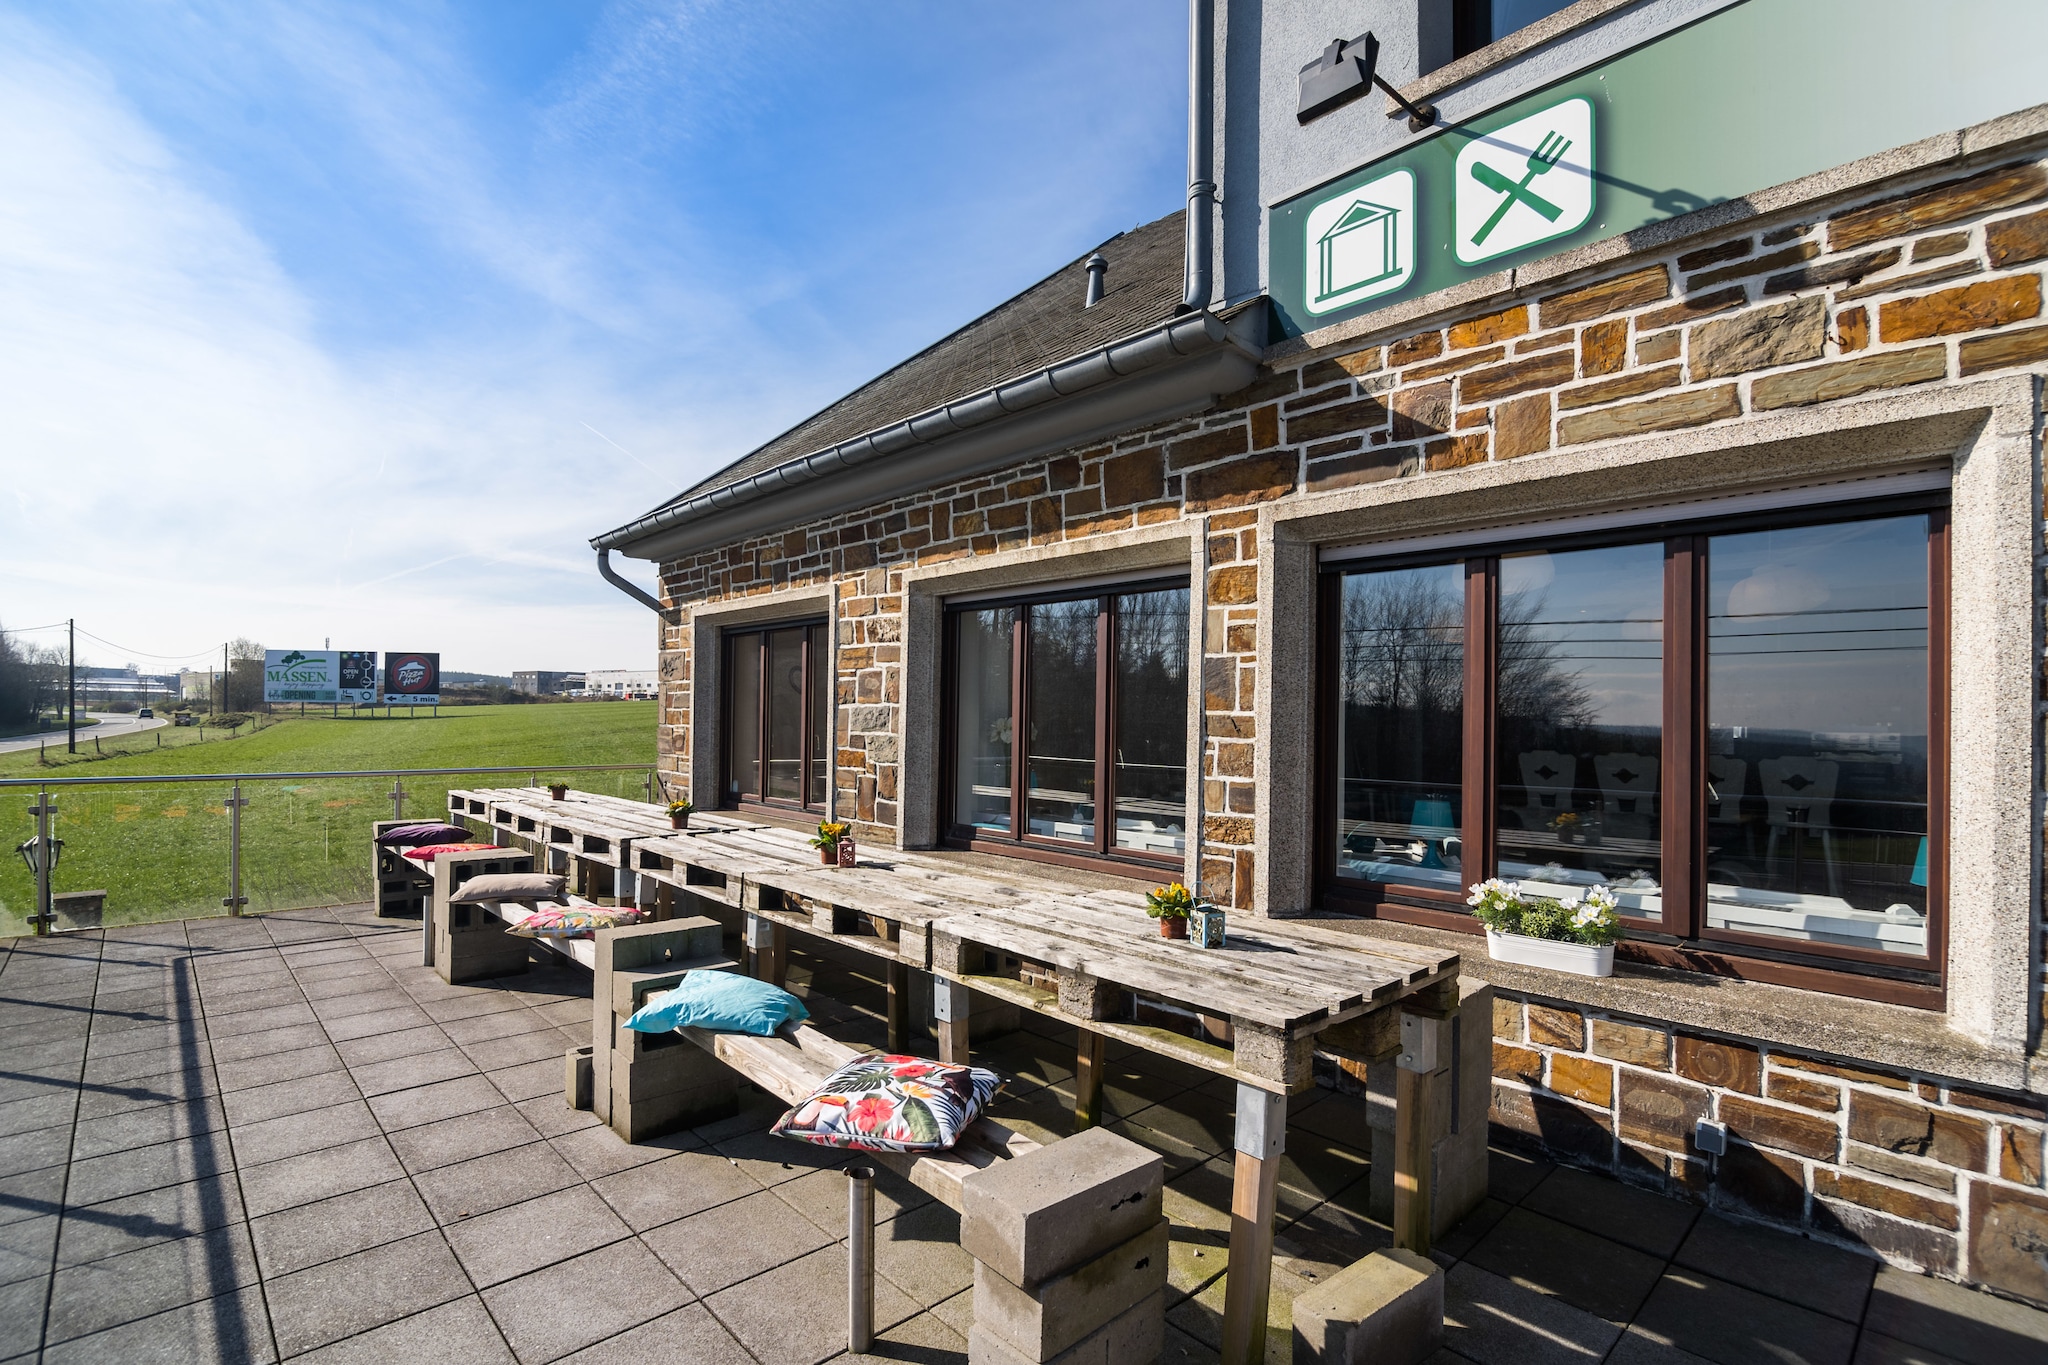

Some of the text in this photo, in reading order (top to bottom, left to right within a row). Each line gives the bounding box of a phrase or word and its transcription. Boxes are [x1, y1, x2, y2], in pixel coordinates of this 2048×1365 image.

[398, 670, 424, 680] Pizza
[402, 677, 422, 686] Hut
[284, 690, 316, 700] OPENING
